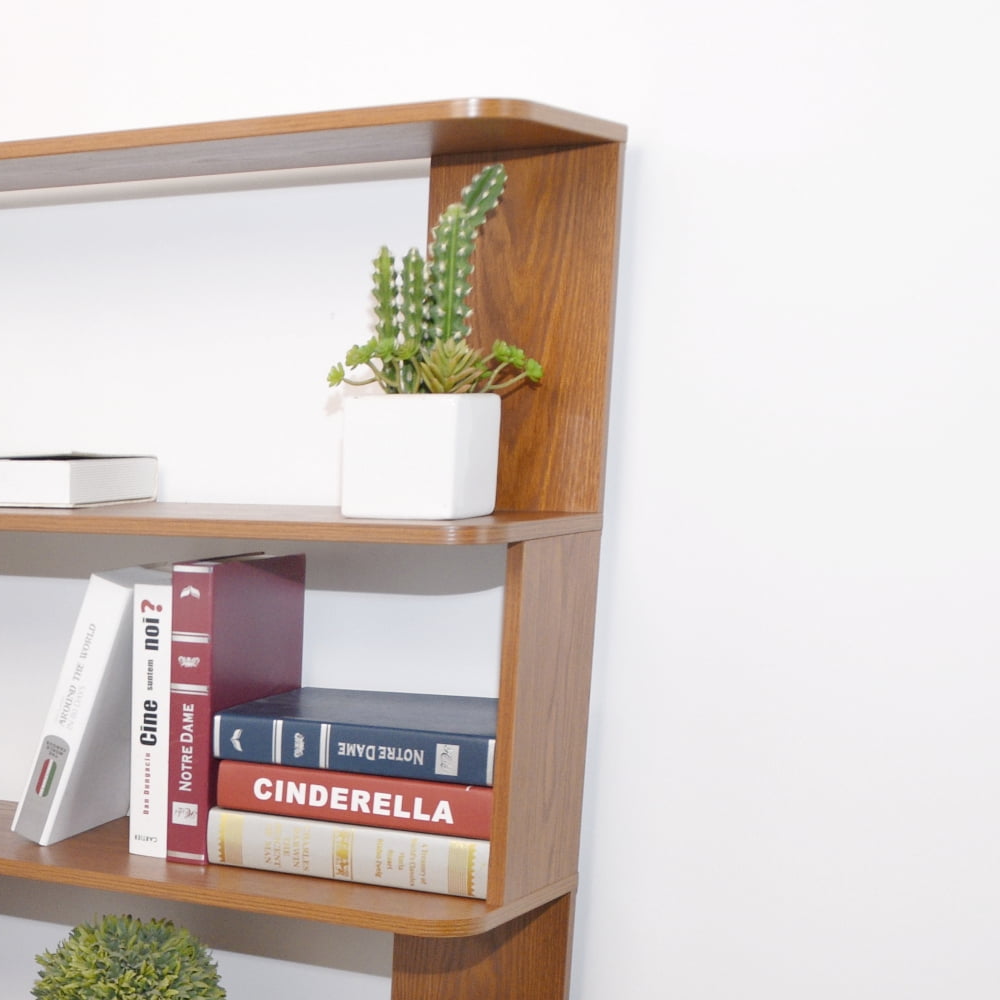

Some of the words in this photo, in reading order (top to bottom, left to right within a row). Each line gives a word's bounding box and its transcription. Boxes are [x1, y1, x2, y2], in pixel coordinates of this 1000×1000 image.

[146, 659, 155, 691] suntem
[140, 700, 158, 746] Cine
[183, 703, 195, 743] DAME
[179, 744, 193, 792] NOTRE
[337, 741, 376, 761] DAME
[378, 747, 424, 766] NOTRE
[252, 777, 454, 824] CINDERELLA
